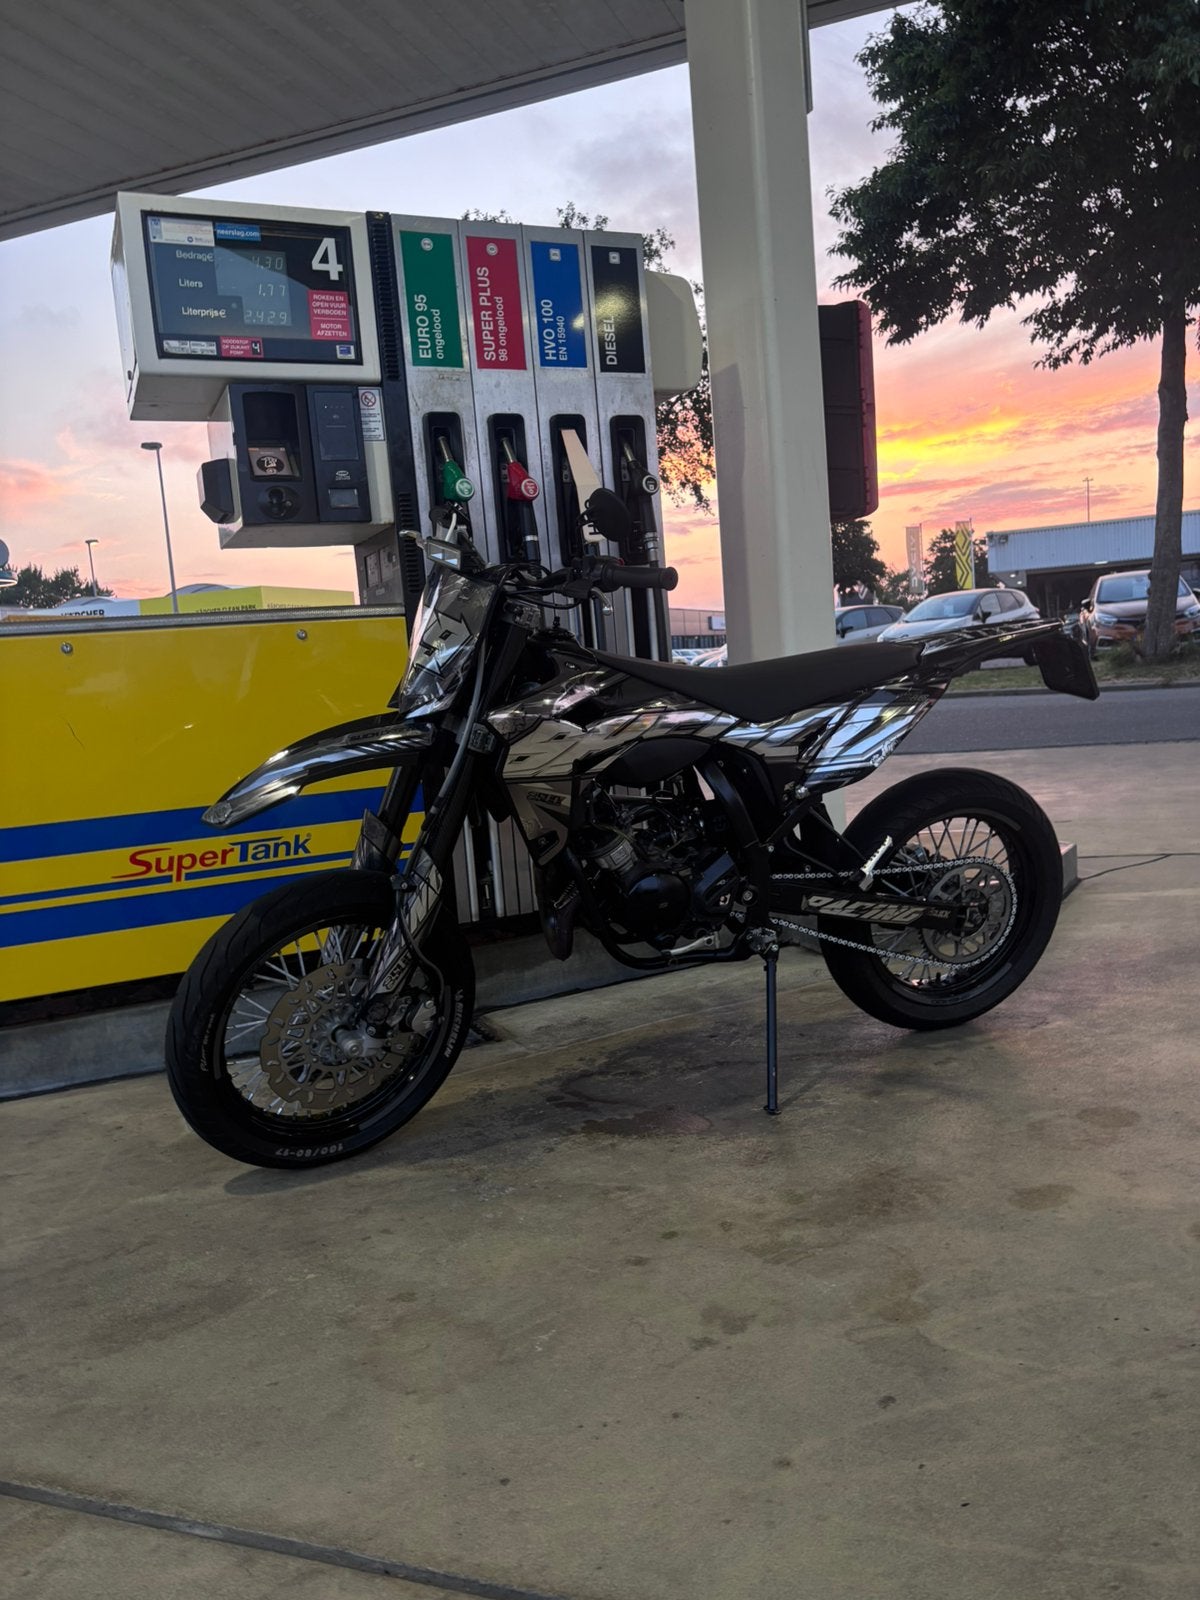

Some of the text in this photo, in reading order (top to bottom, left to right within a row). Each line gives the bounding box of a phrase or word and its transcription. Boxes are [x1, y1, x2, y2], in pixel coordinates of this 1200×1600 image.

[179, 278, 203, 288] Liters
[312, 237, 343, 280] 4
[414, 294, 432, 358] EURO 95
[431, 308, 445, 359] ongelood
[476, 266, 496, 361] SUPER PLUS
[494, 296, 508, 361] 98 ongelood
[541, 299, 557, 360] HVO 100
[556, 315, 568, 361] EN 15940
[603, 315, 617, 365] DIESEL
